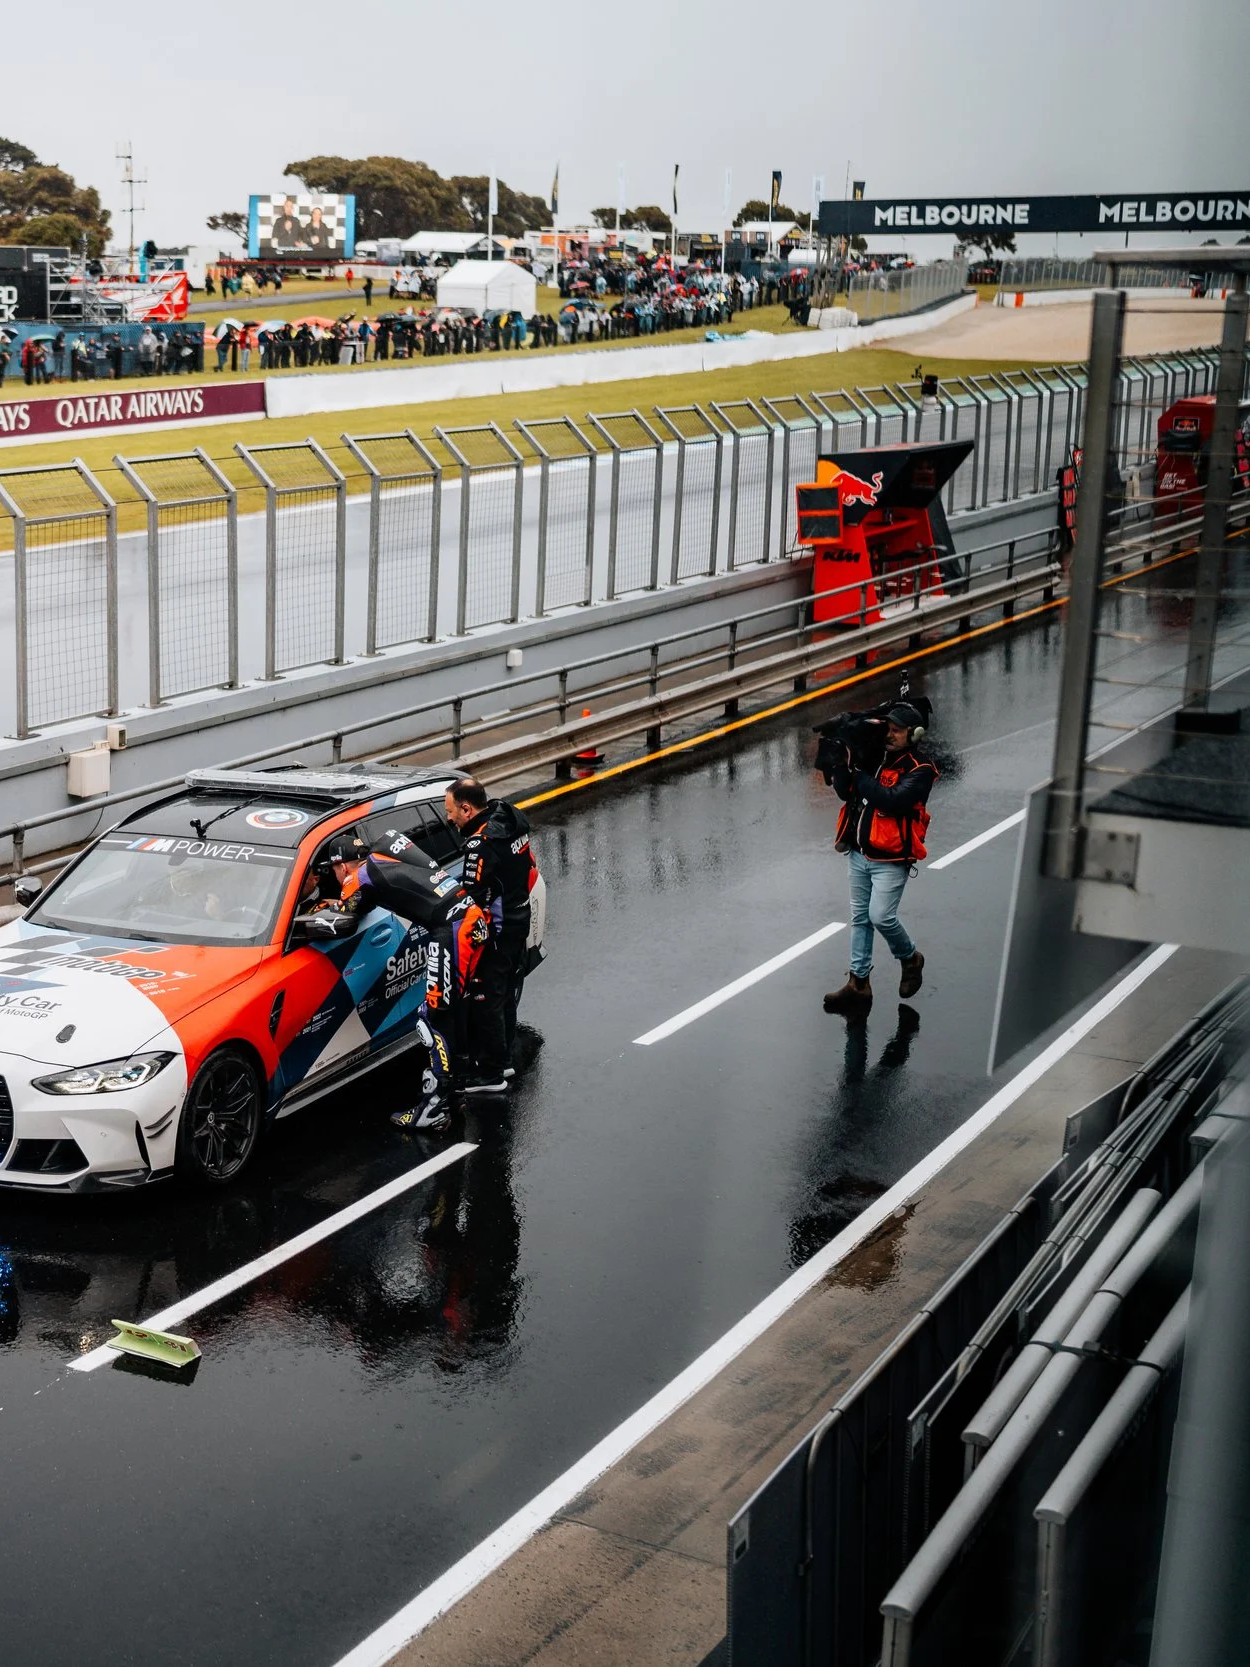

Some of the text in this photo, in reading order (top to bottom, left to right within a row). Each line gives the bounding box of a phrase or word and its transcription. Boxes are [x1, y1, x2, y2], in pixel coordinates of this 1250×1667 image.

[874, 204, 1030, 227] MELBOURNE
[56, 388, 205, 429] QATAR AIRWAYS
[822, 550, 861, 563] KTM
[172, 841, 256, 860] POWER
[386, 944, 429, 981] Safety
[426, 941, 443, 1009] aprilia
[443, 947, 453, 1006] IXON
[385, 977, 410, 999] Official
[4, 1008, 48, 1020] MotoGP
[20, 996, 62, 1010] Car
[433, 1034, 450, 1072] IXON
